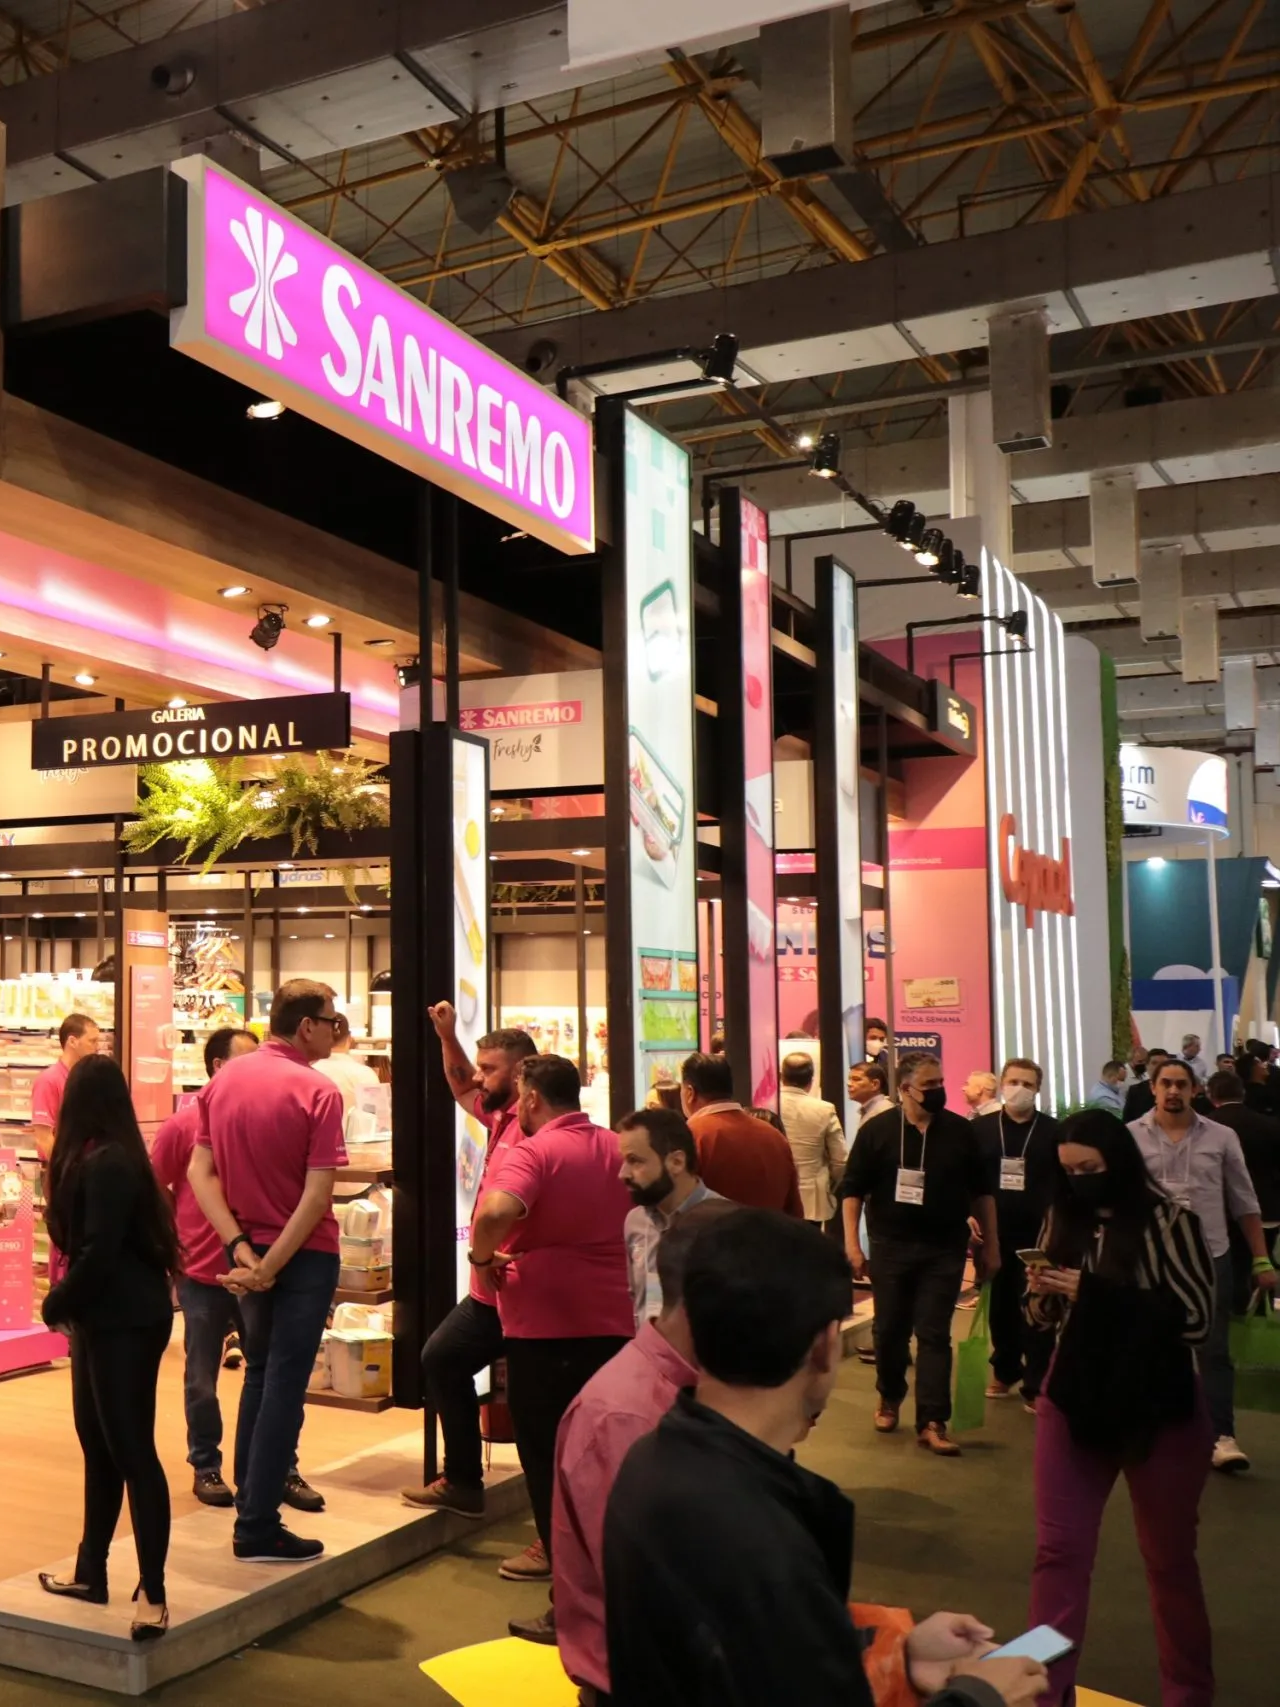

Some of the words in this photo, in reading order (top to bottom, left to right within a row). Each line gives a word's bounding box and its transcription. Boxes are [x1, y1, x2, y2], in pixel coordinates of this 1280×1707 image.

[321, 264, 576, 520] SANREMO
[151, 707, 205, 724] GALERIA
[482, 705, 575, 728] SANREMO
[62, 721, 302, 763] PROMOCIONAL
